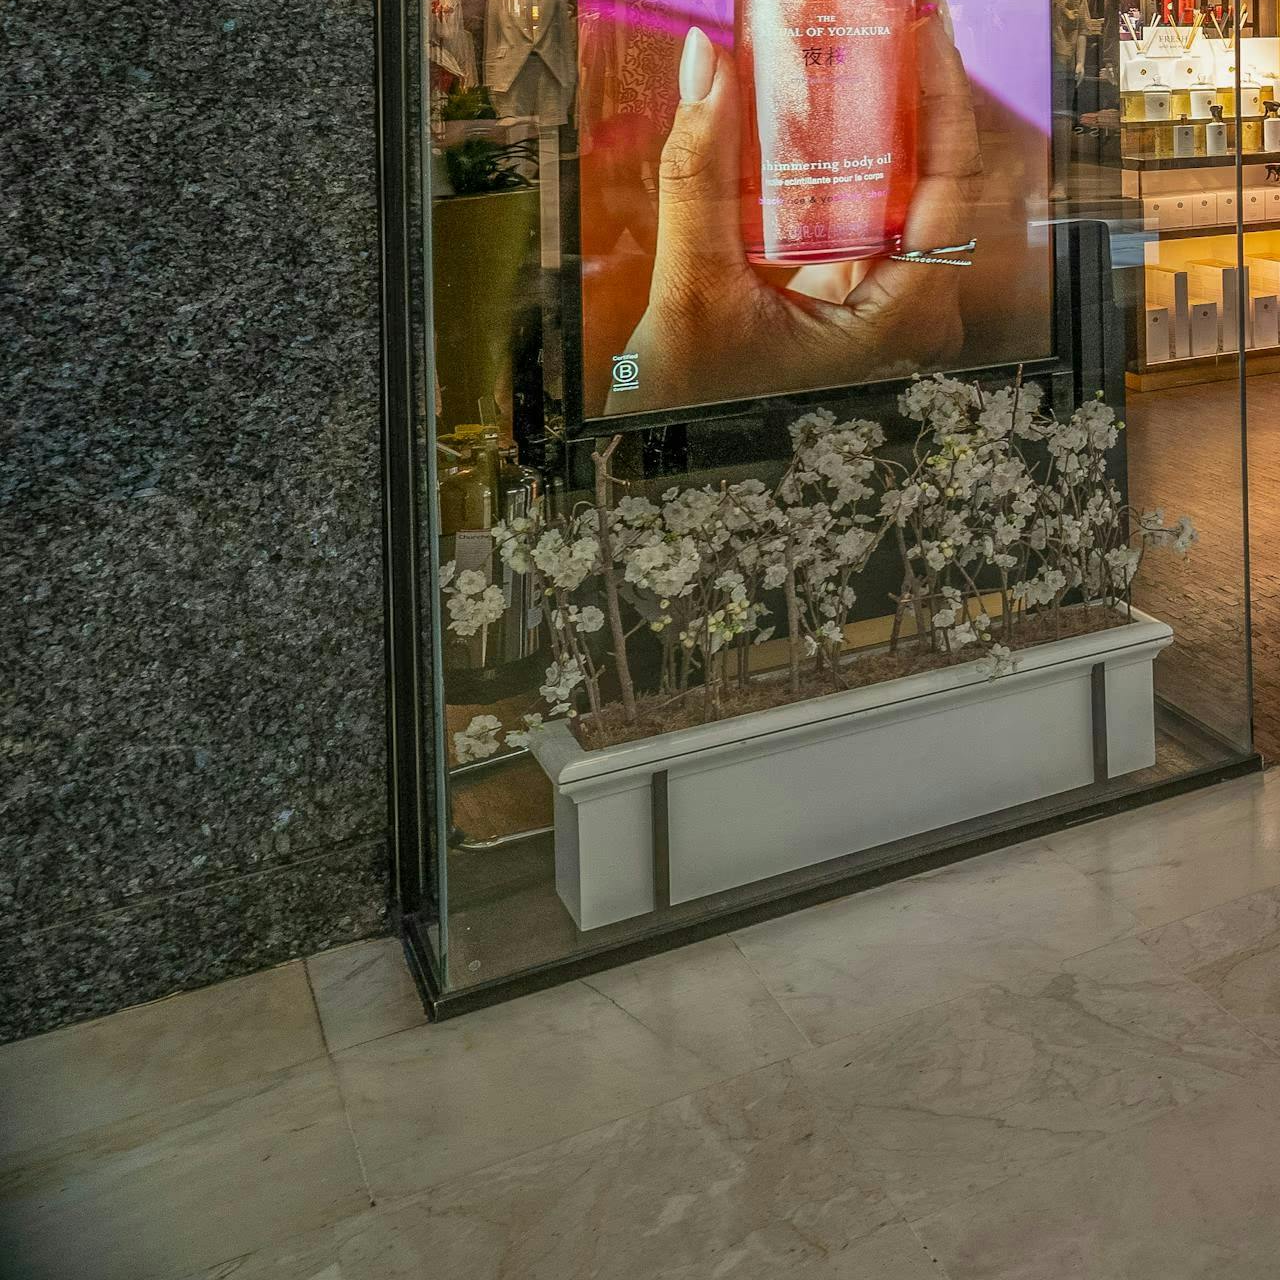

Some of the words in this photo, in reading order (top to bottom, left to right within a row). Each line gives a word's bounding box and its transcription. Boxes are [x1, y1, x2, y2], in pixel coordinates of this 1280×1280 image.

[806, 27, 827, 37] OF
[828, 26, 891, 36] YOZAKURA
[843, 155, 873, 169] body
[877, 153, 891, 164] oil
[833, 174, 854, 184] pour
[864, 172, 884, 182] corps
